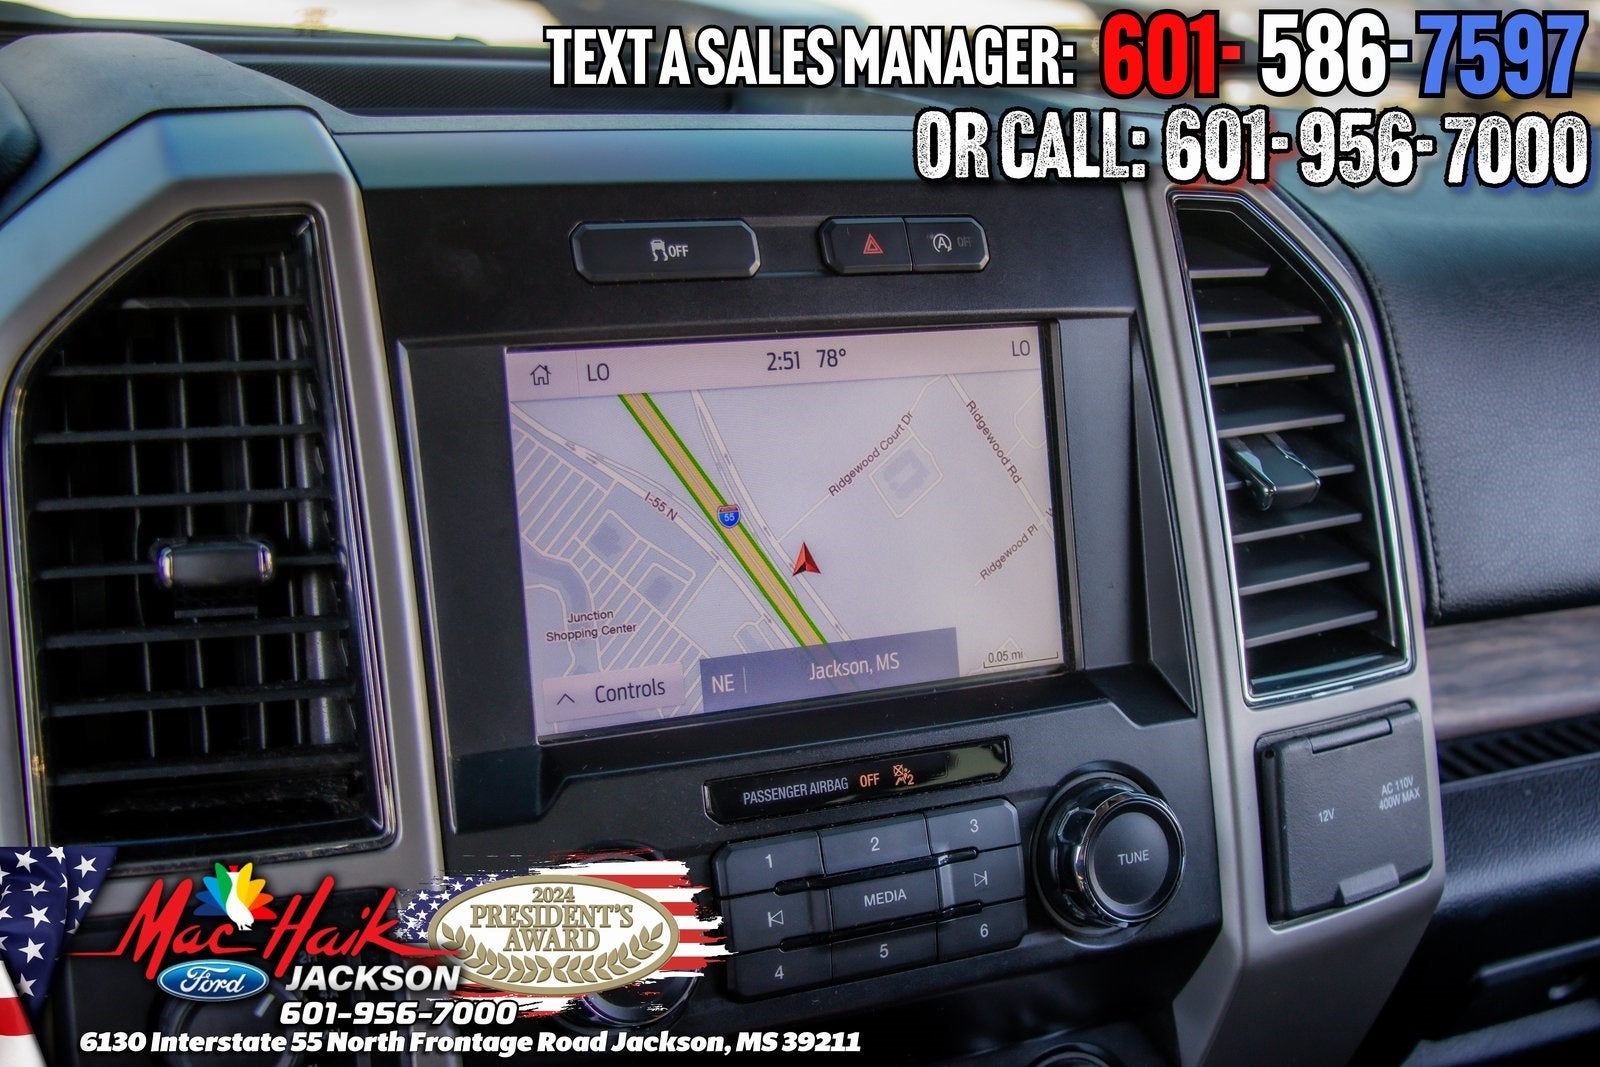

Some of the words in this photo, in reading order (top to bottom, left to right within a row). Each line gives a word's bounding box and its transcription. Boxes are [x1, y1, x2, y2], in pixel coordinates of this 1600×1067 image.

[667, 243, 690, 260] OFF
[1011, 340, 1031, 357] LO
[766, 350, 801, 371] 2:51
[815, 347, 847, 368] 78°
[586, 362, 610, 382] LO
[965, 400, 1012, 467] Ridgewood
[1006, 465, 1022, 484] Rd
[828, 447, 881, 497] Ridgewood
[879, 423, 905, 452] Court
[901, 410, 914, 427] Dr
[644, 491, 668, 514] I-55
[666, 507, 679, 521] N
[723, 512, 736, 522] 55
[979, 532, 1030, 581] Ridgewood
[1027, 523, 1039, 537] Pl
[567, 609, 615, 624] Junction
[546, 626, 598, 642] Shopping
[601, 622, 637, 636] Center
[988, 650, 1008, 664] 0.05
[1011, 648, 1024, 660] mi
[711, 673, 735, 694] NE
[809, 657, 874, 681] Jackson,
[876, 651, 900, 671] MS
[594, 677, 667, 704] Controls
[743, 779, 808, 806] PASSENGER
[809, 776, 849, 796] AIRBAG
[858, 772, 881, 789] OFF
[1380, 781, 1394, 796] AC
[1394, 774, 1415, 791] 110V
[1378, 792, 1402, 812] 400W
[1400, 786, 1421, 804] MAX
[1317, 807, 1335, 823] 12V
[969, 818, 980, 834] 3
[869, 836, 881, 852] 2
[764, 853, 774, 869] 1
[1117, 848, 1150, 866] TUNE
[863, 887, 908, 908] MEDIA
[979, 923, 990, 938] 6
[879, 943, 890, 959] 5
[773, 964, 785, 980] 4
